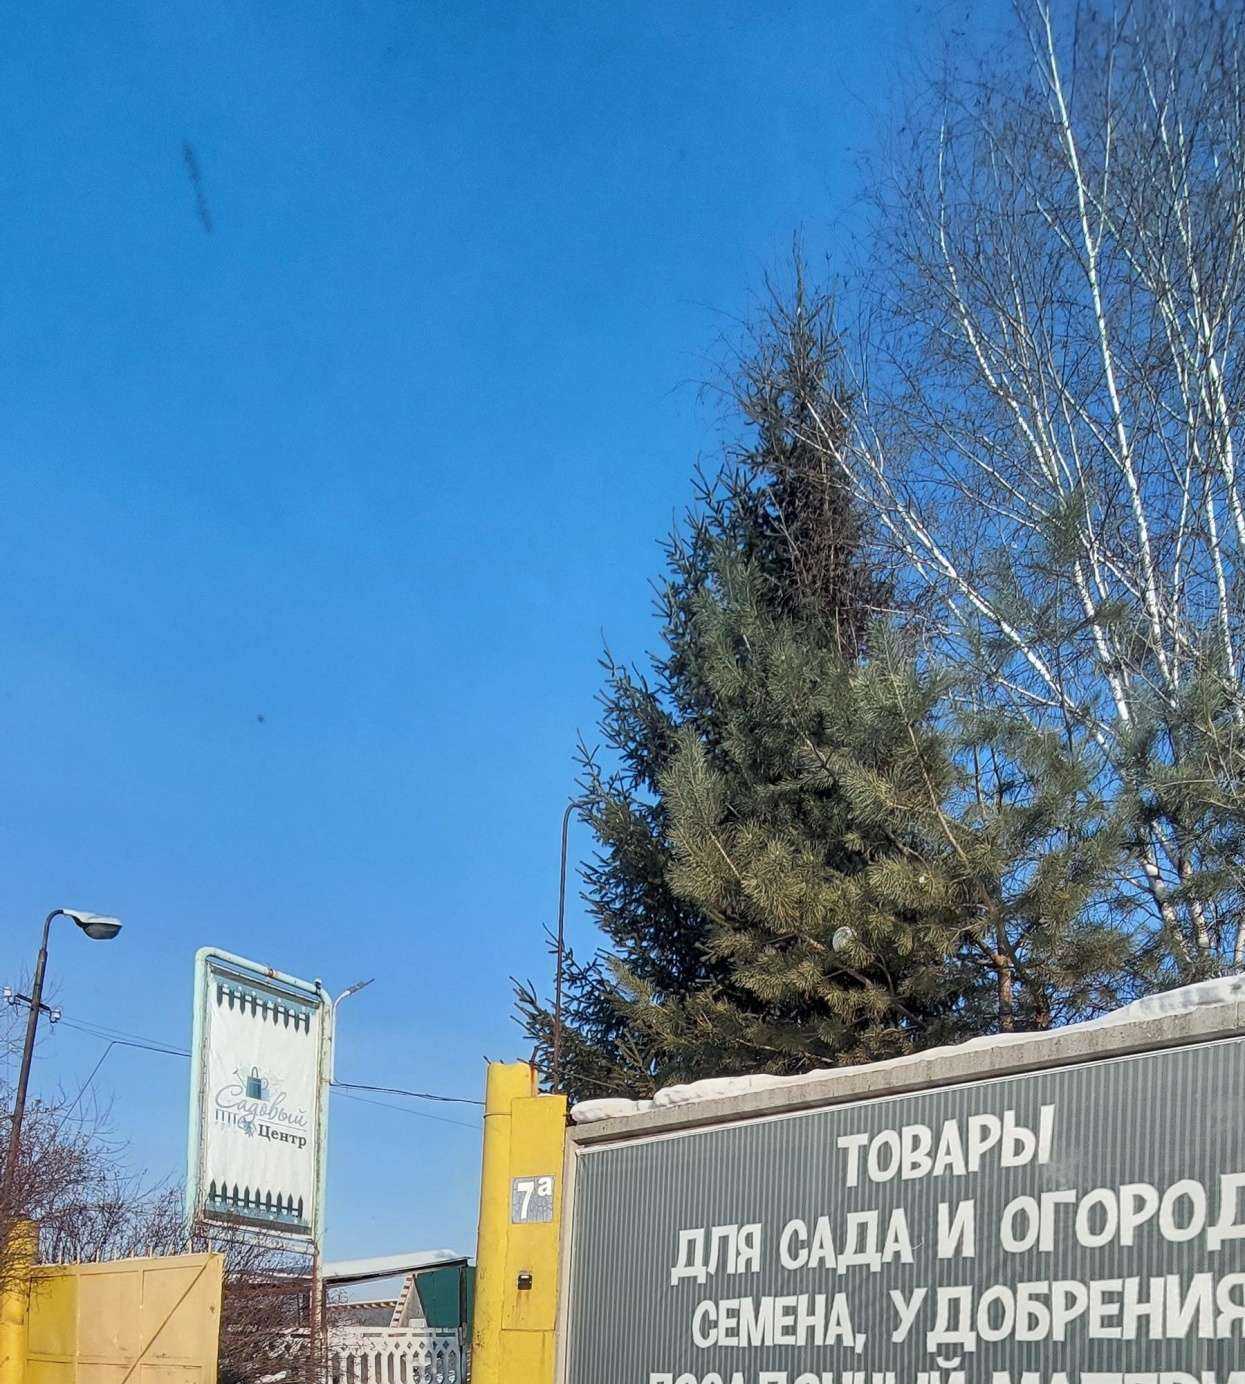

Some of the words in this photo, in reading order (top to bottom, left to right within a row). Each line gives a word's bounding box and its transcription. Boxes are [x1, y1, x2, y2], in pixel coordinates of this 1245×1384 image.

[215, 1084, 308, 1127] Садовый
[258, 1124, 307, 1149] Центр
[837, 1104, 1055, 1187] ТОВАРЫ
[670, 1223, 762, 1286] ДЛЯ
[779, 1207, 914, 1274] САДА
[936, 1199, 975, 1259] И
[692, 1292, 867, 1354] СЕМЕНА,
[890, 1272, 1245, 1352] УДОБРЕНИЯ
